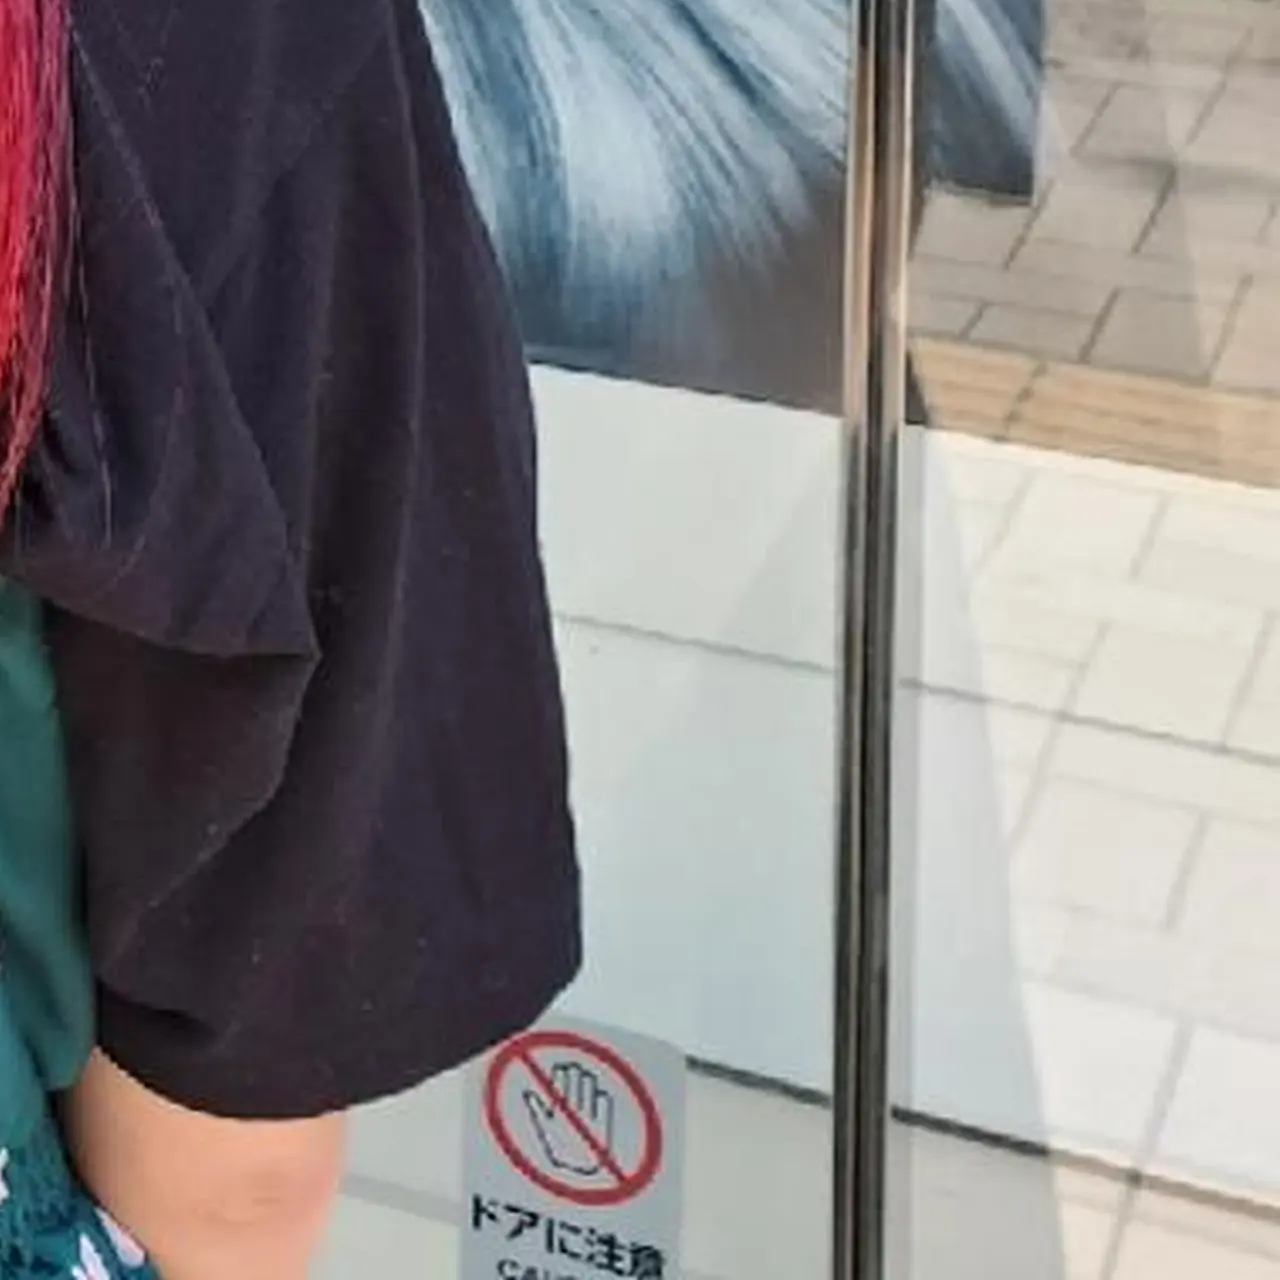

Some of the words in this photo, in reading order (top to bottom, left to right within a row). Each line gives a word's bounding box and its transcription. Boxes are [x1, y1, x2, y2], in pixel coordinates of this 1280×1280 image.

[473, 1193, 663, 1280] ドアに注意
